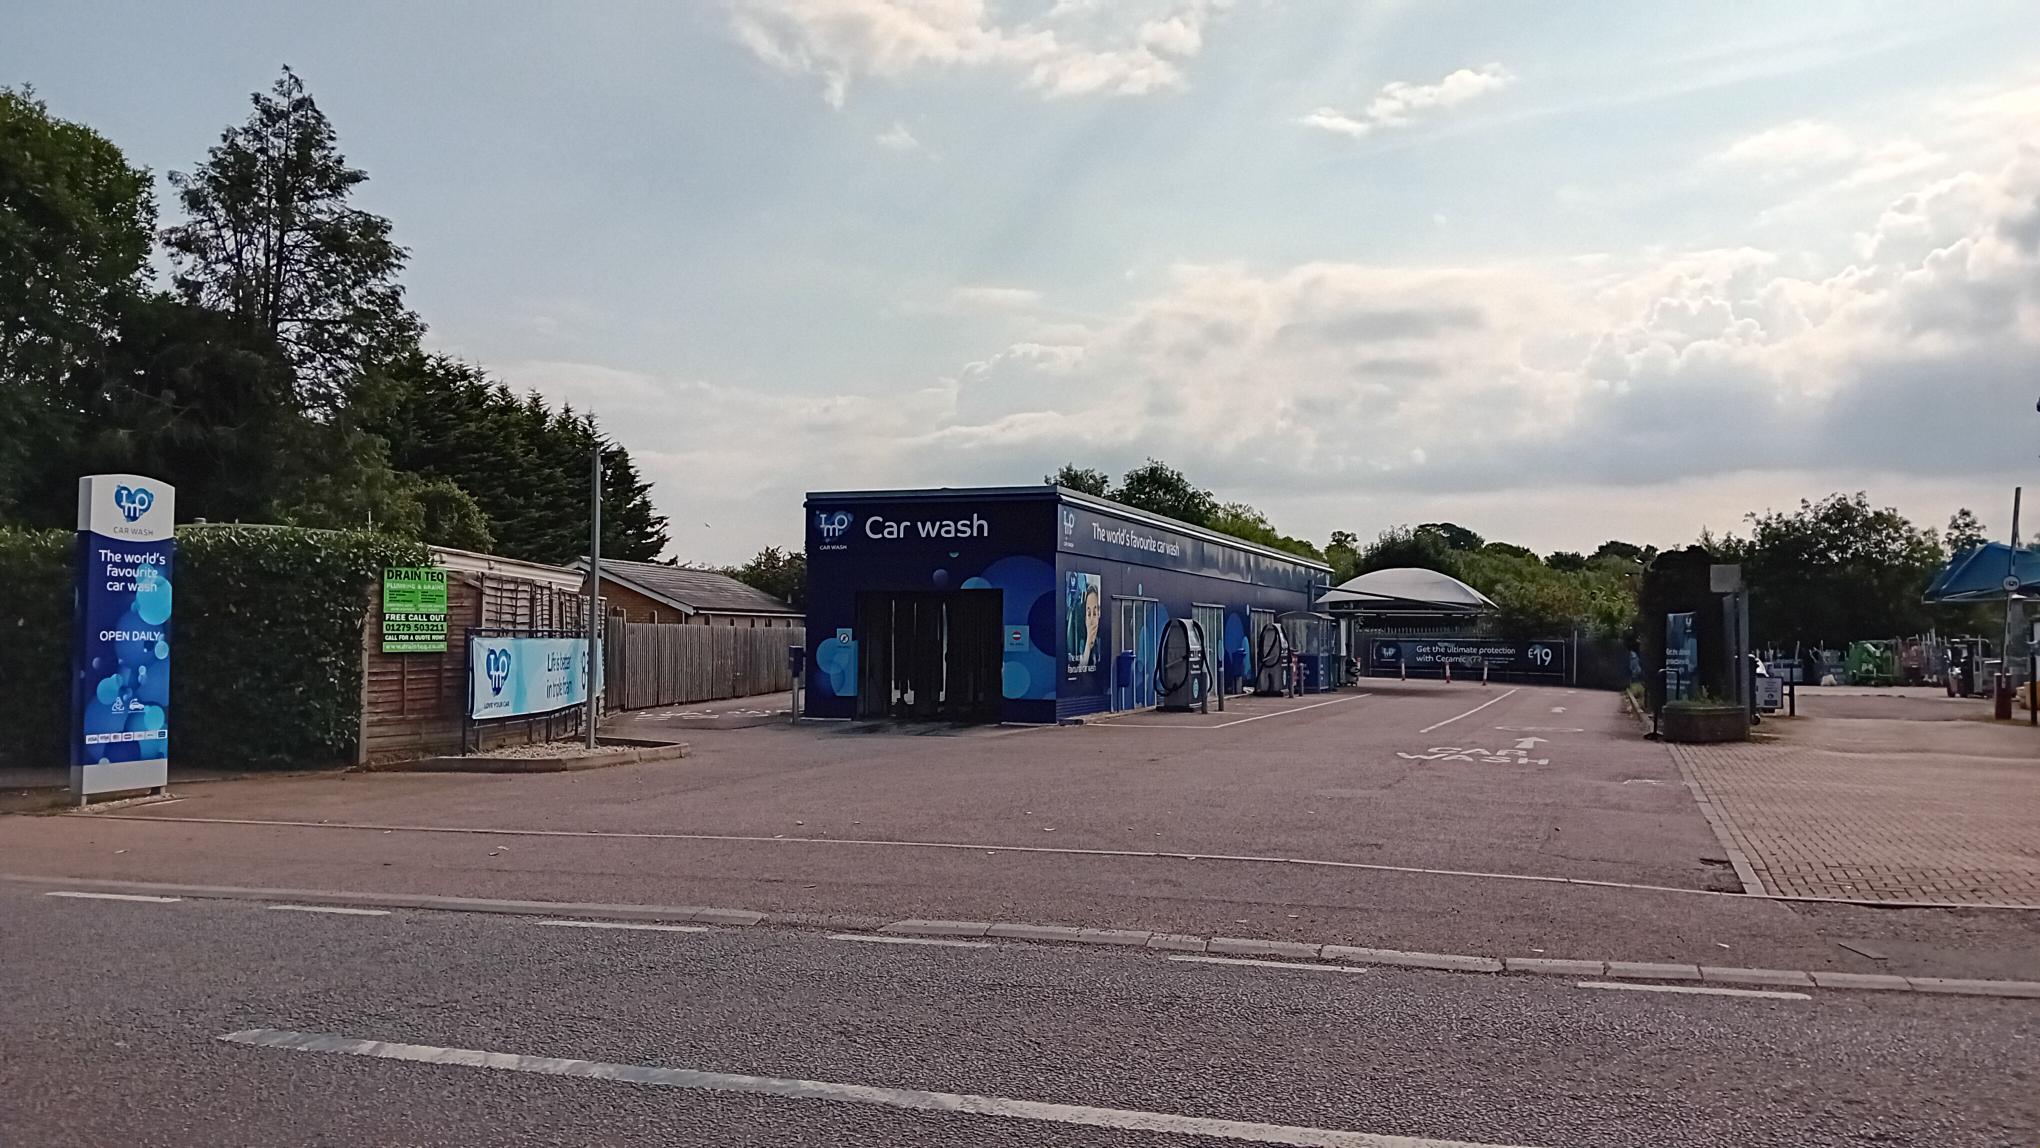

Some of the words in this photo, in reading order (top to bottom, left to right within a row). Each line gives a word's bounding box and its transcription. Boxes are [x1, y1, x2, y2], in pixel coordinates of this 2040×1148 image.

[113, 526, 129, 534] CAR
[130, 527, 154, 536] WASH
[865, 516, 911, 539] Car
[917, 513, 988, 538] wash
[1092, 522, 1106, 542] The
[1106, 528, 1130, 547] world's
[1130, 530, 1157, 552] favourite
[1157, 541, 1166, 553] car
[1166, 542, 1180, 557] wash
[98, 550, 122, 562] The
[124, 552, 166, 565] world's
[106, 564, 158, 578] favourite
[386, 570, 421, 581] DRAIN
[424, 571, 445, 583] TEQ
[106, 581, 125, 591] car
[127, 582, 158, 593] wash
[385, 613, 406, 621] FREE
[385, 623, 412, 632] 01279
[413, 623, 445, 632] 503211
[99, 630, 130, 642] OPEN
[132, 630, 161, 641] DAILY
[1416, 645, 1431, 653] Get
[1432, 645, 1446, 653] the
[1447, 646, 1478, 654] ultimate
[1478, 647, 1516, 655] protection
[1416, 654, 1434, 662] with
[1435, 654, 1466, 663] Ceramic
[1427, 746, 1528, 756] CAR
[1396, 752, 1549, 765] WASH
